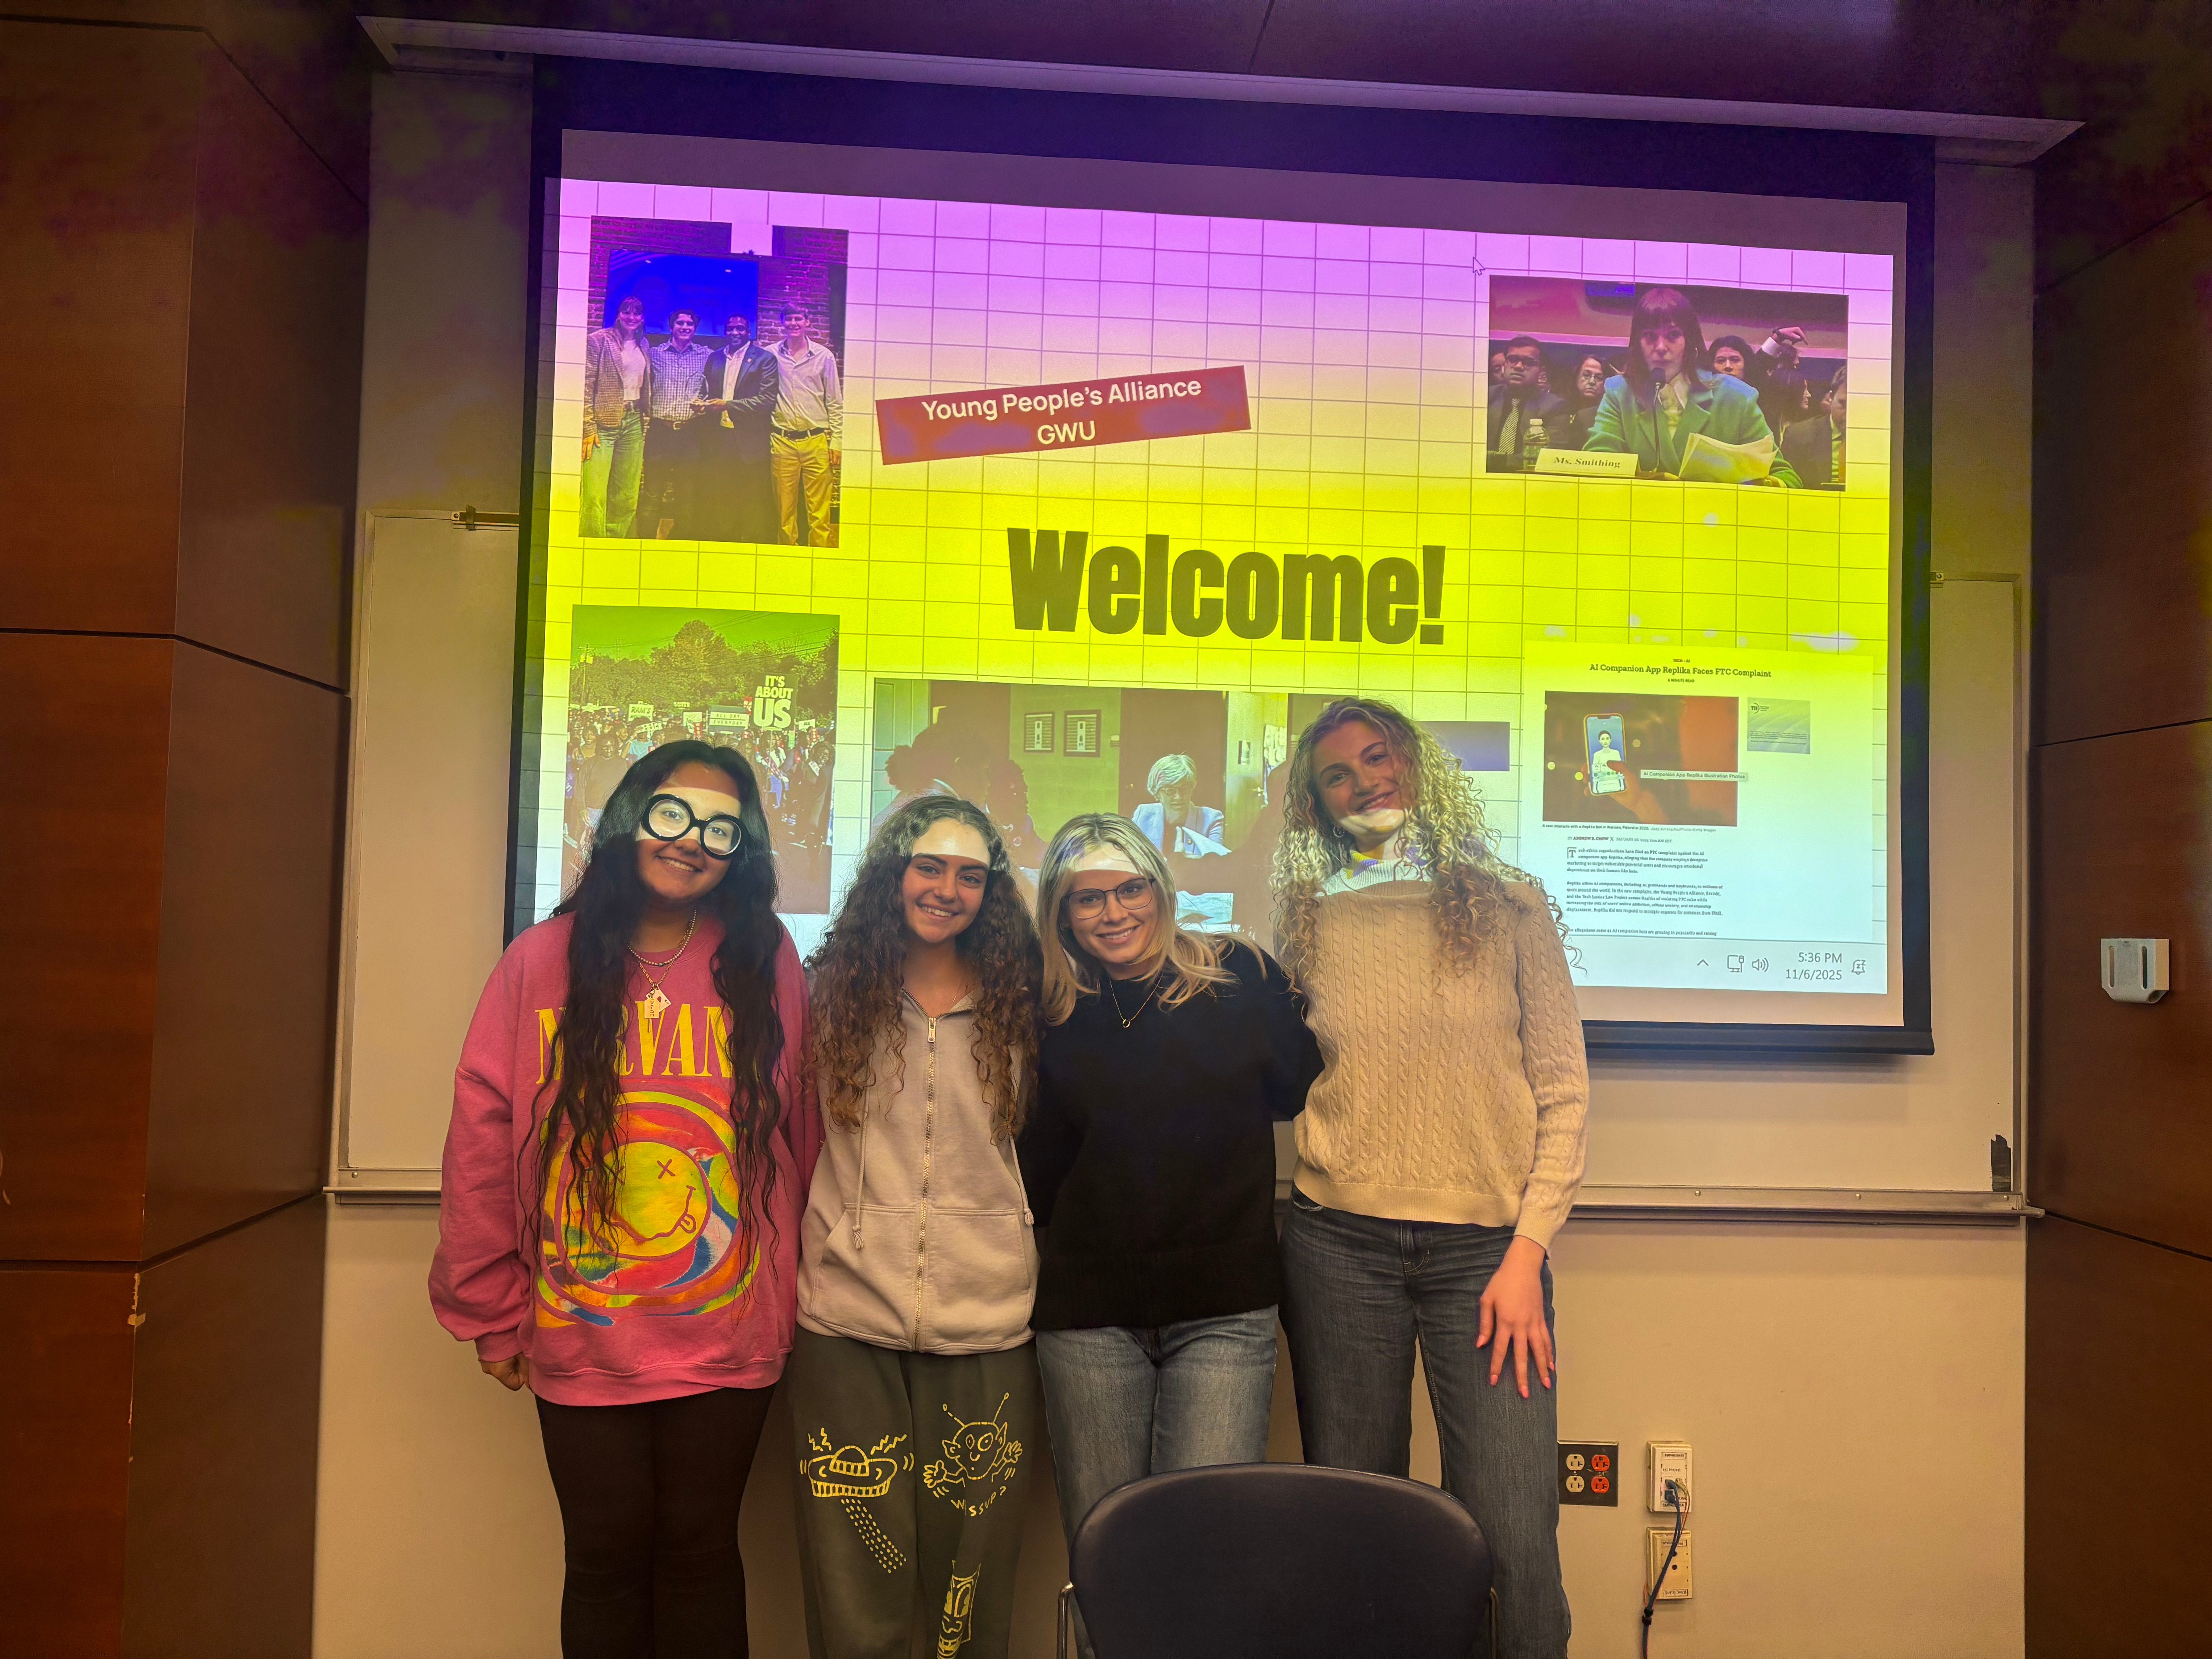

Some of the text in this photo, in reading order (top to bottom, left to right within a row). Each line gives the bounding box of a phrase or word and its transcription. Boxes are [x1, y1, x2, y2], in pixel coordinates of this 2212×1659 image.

[922, 380, 1202, 421] Young People’s Alliance
[1037, 421, 1096, 445] GWU
[1575, 459, 1620, 468] Smithing
[1006, 527, 1446, 645] Welcome!
[1645, 666, 1661, 674] App
[1663, 666, 1690, 675] Replika
[1732, 669, 1771, 678] Complaint
[766, 675, 785, 687] IT'S
[755, 686, 793, 699] ABOUT
[754, 697, 791, 728] US
[1798, 952, 1842, 963] 5:36 PM
[1786, 969, 1842, 981] 11/6/2025
